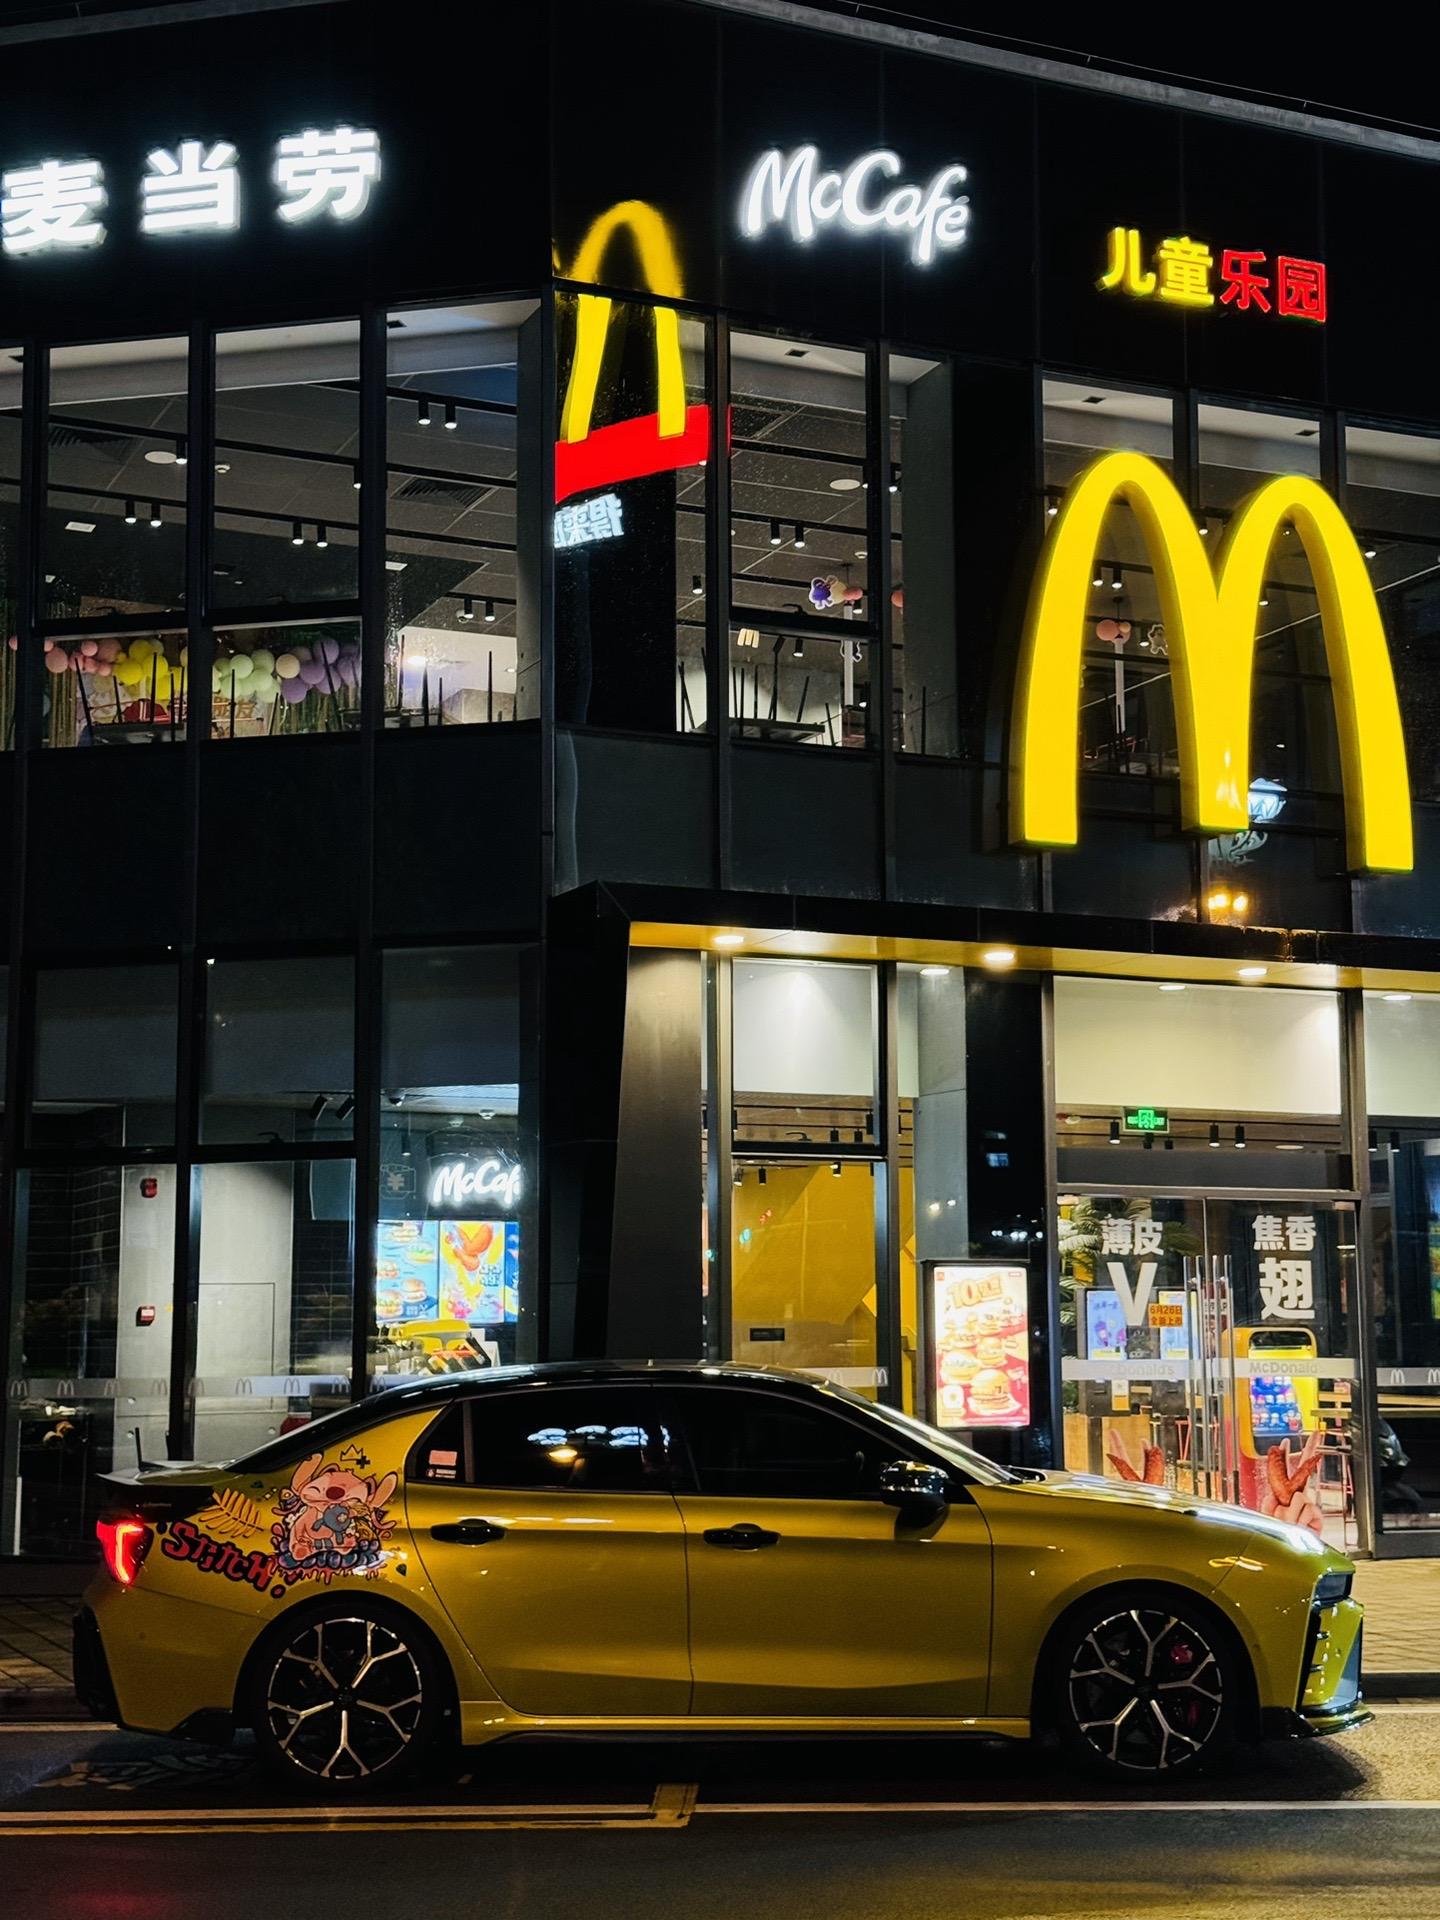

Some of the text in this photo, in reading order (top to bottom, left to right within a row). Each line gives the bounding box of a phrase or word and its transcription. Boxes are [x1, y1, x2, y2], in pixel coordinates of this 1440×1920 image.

[1, 125, 382, 256] 麦当劳
[739, 144, 971, 267] McCafé
[1098, 226, 1328, 323] 儿童乐园
[1101, 1215, 1164, 1256] 薄皮
[1252, 1215, 1317, 1251] 焦香
[1106, 1261, 1158, 1326] V
[1258, 1257, 1316, 1320] 翅
